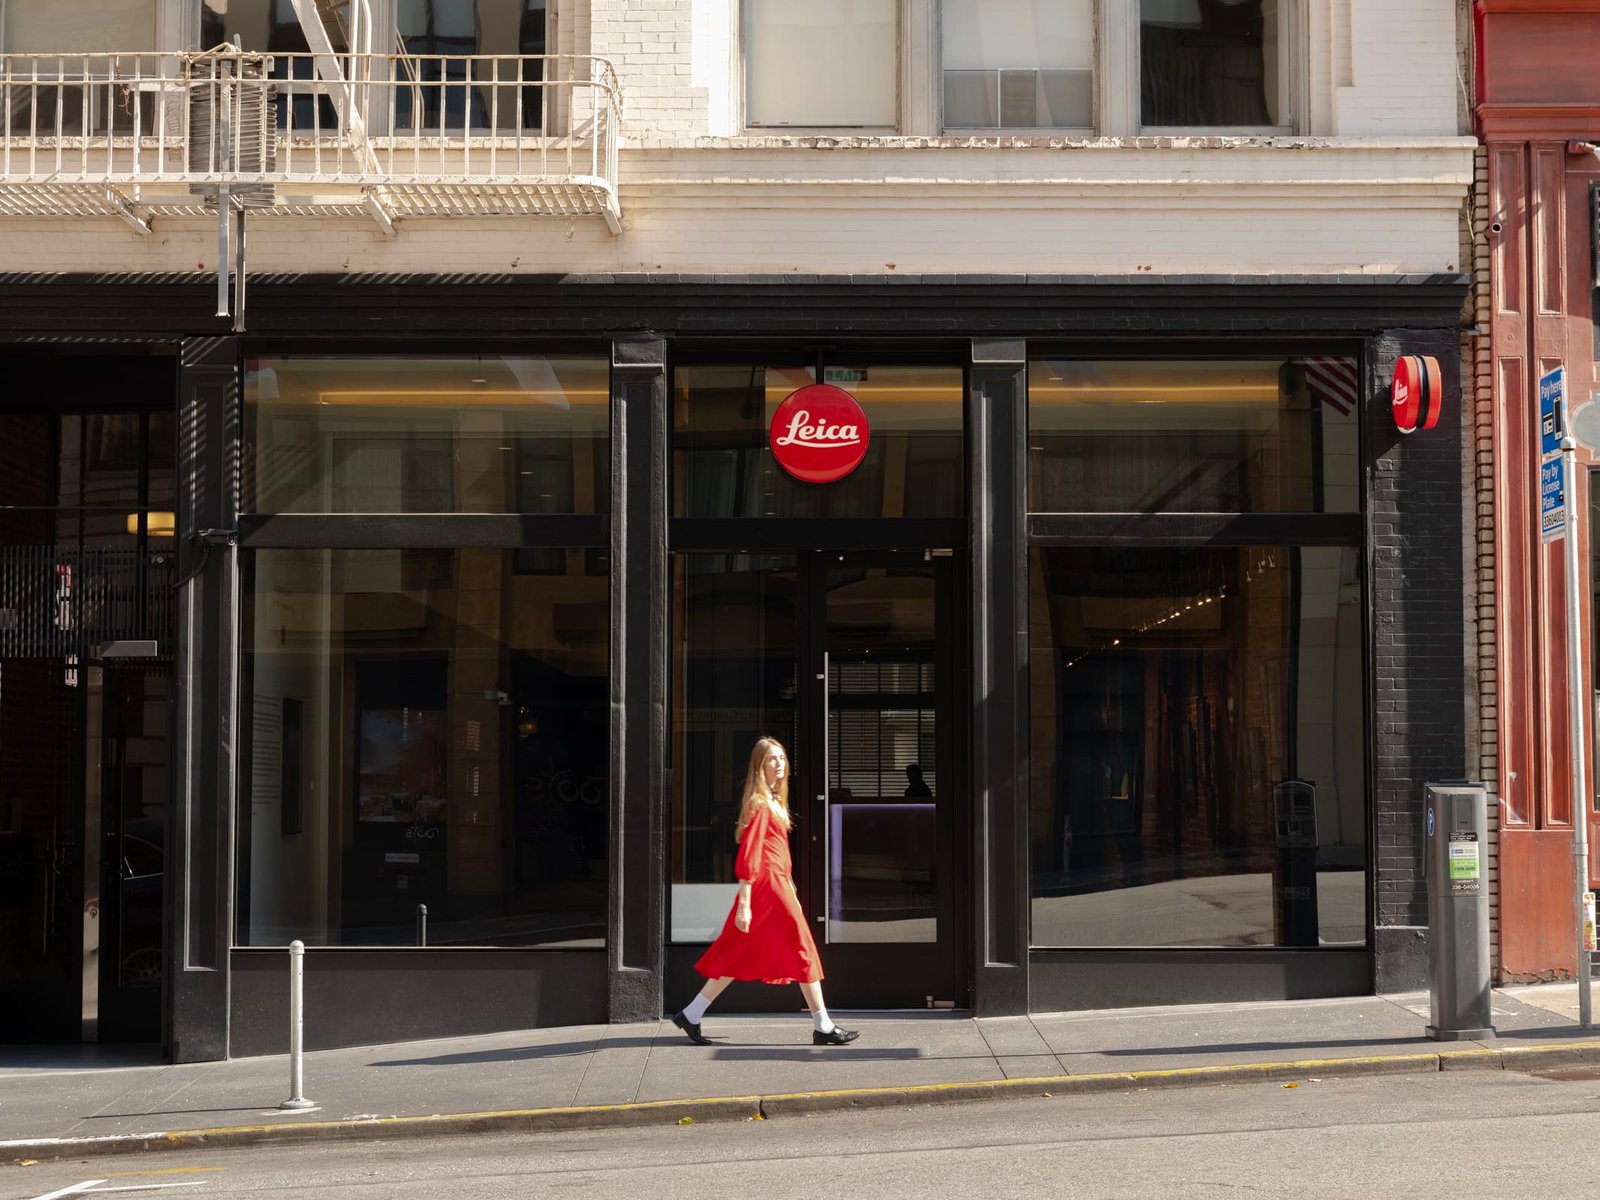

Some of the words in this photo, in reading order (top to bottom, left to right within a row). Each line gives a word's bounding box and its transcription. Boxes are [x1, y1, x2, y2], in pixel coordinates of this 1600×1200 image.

[1541, 385, 1550, 400] Pay
[776, 410, 860, 448] Leica
[1542, 467, 1551, 482] Pay
[1551, 464, 1559, 479] by
[1542, 480, 1560, 496] License
[1542, 495, 1555, 509] Plate
